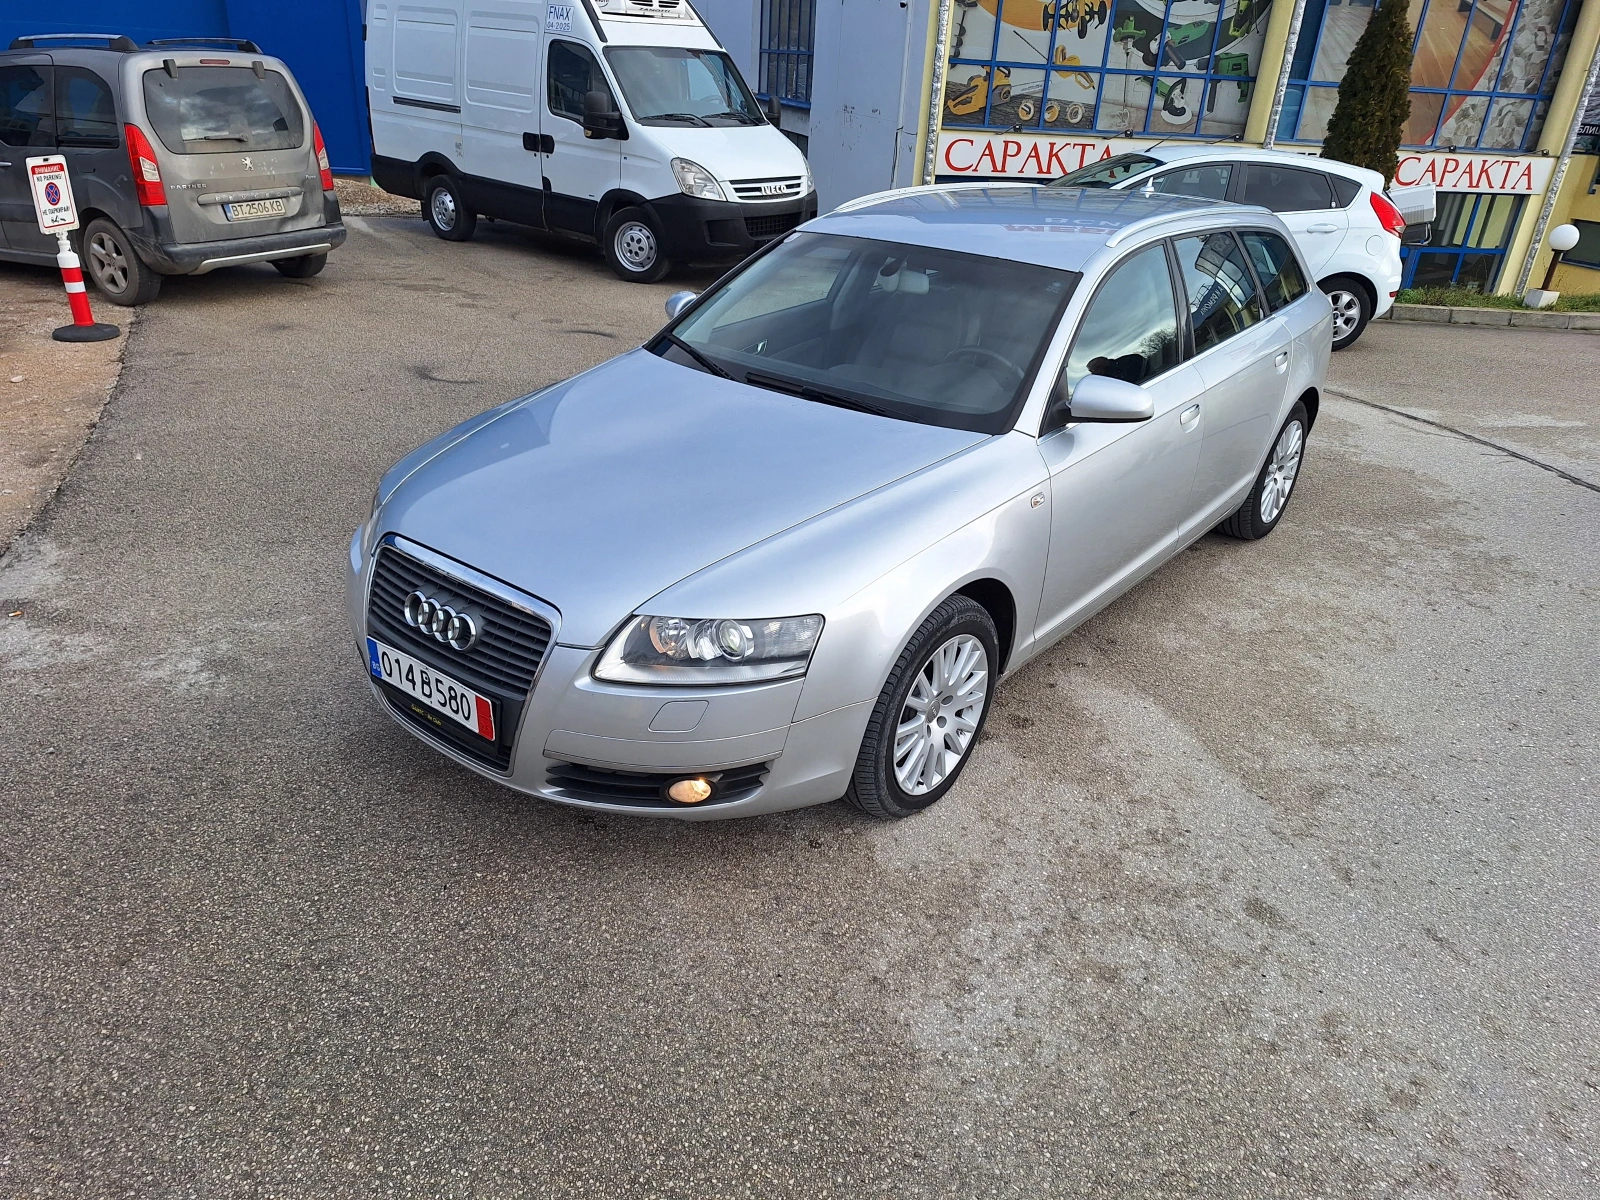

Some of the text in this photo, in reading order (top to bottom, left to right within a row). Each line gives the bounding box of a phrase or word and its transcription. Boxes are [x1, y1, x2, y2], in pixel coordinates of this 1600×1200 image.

[548, 5, 571, 21] FNAX
[1394, 156, 1533, 190] САРАКТА
[761, 184, 787, 195] IVECO
